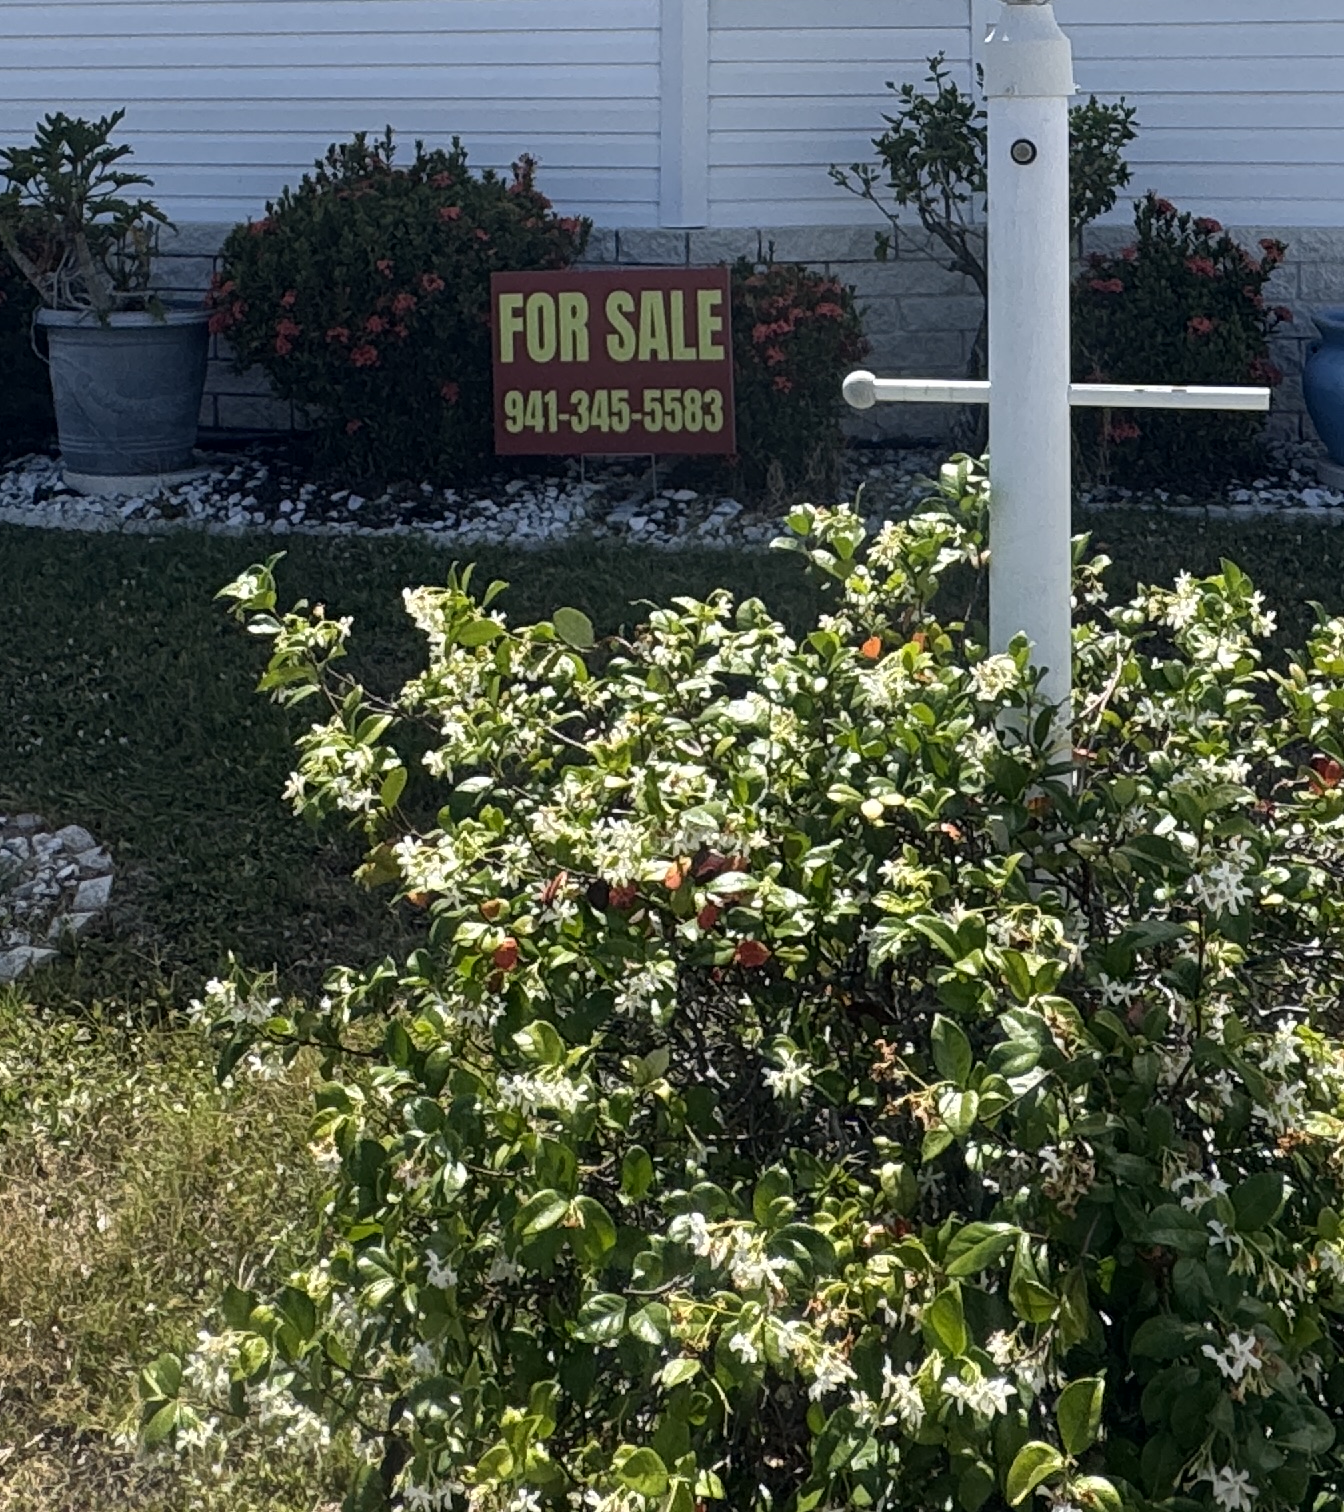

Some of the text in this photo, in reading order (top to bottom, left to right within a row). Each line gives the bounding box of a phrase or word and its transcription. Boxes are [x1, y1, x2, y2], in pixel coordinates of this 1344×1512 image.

[499, 289, 725, 363] FOR SALE
[504, 389, 724, 433] 941-345-5583
